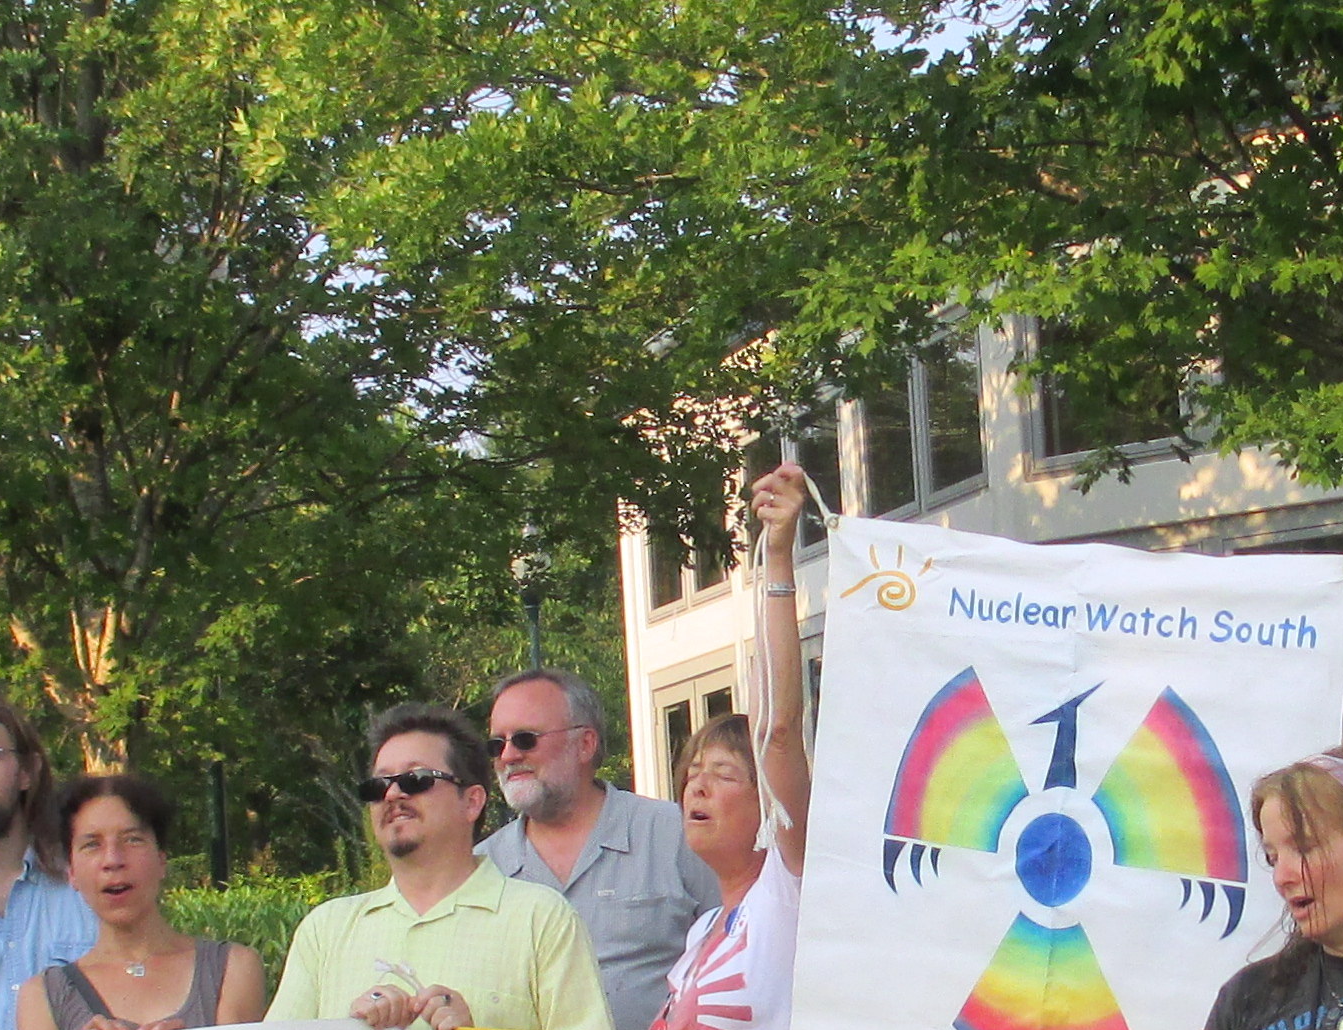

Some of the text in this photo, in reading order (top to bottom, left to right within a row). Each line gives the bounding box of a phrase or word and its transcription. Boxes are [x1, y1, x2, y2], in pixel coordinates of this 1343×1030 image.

[948, 586, 1318, 649] Nuclear Watch South
